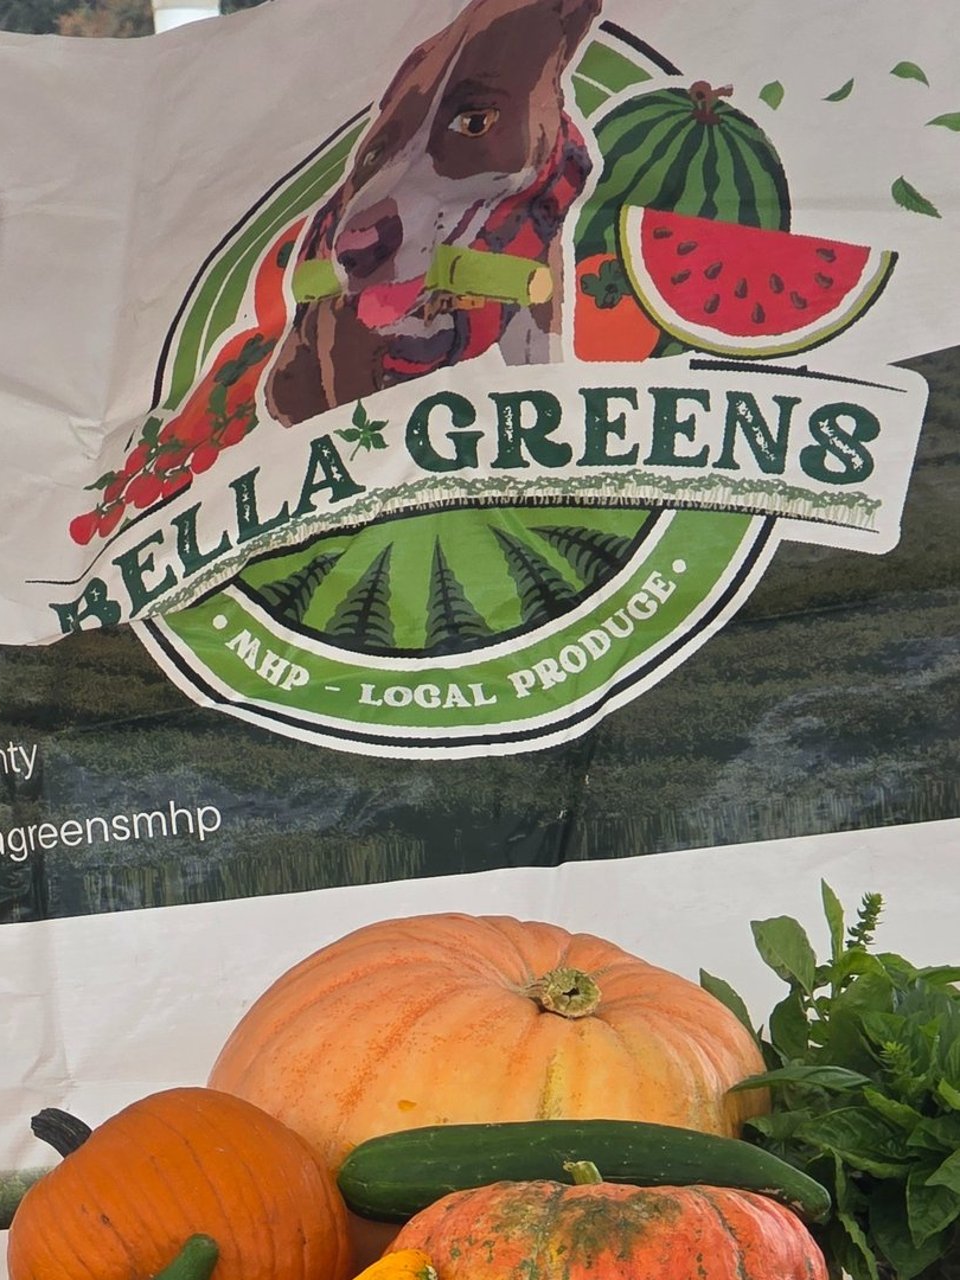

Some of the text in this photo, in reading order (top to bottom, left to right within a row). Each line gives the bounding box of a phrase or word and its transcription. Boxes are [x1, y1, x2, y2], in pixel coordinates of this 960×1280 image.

[48, 386, 882, 633] BELLA GREENS
[225, 628, 311, 692] MHP
[358, 681, 497, 708] LOCAL
[506, 570, 677, 699] PRODUCE
